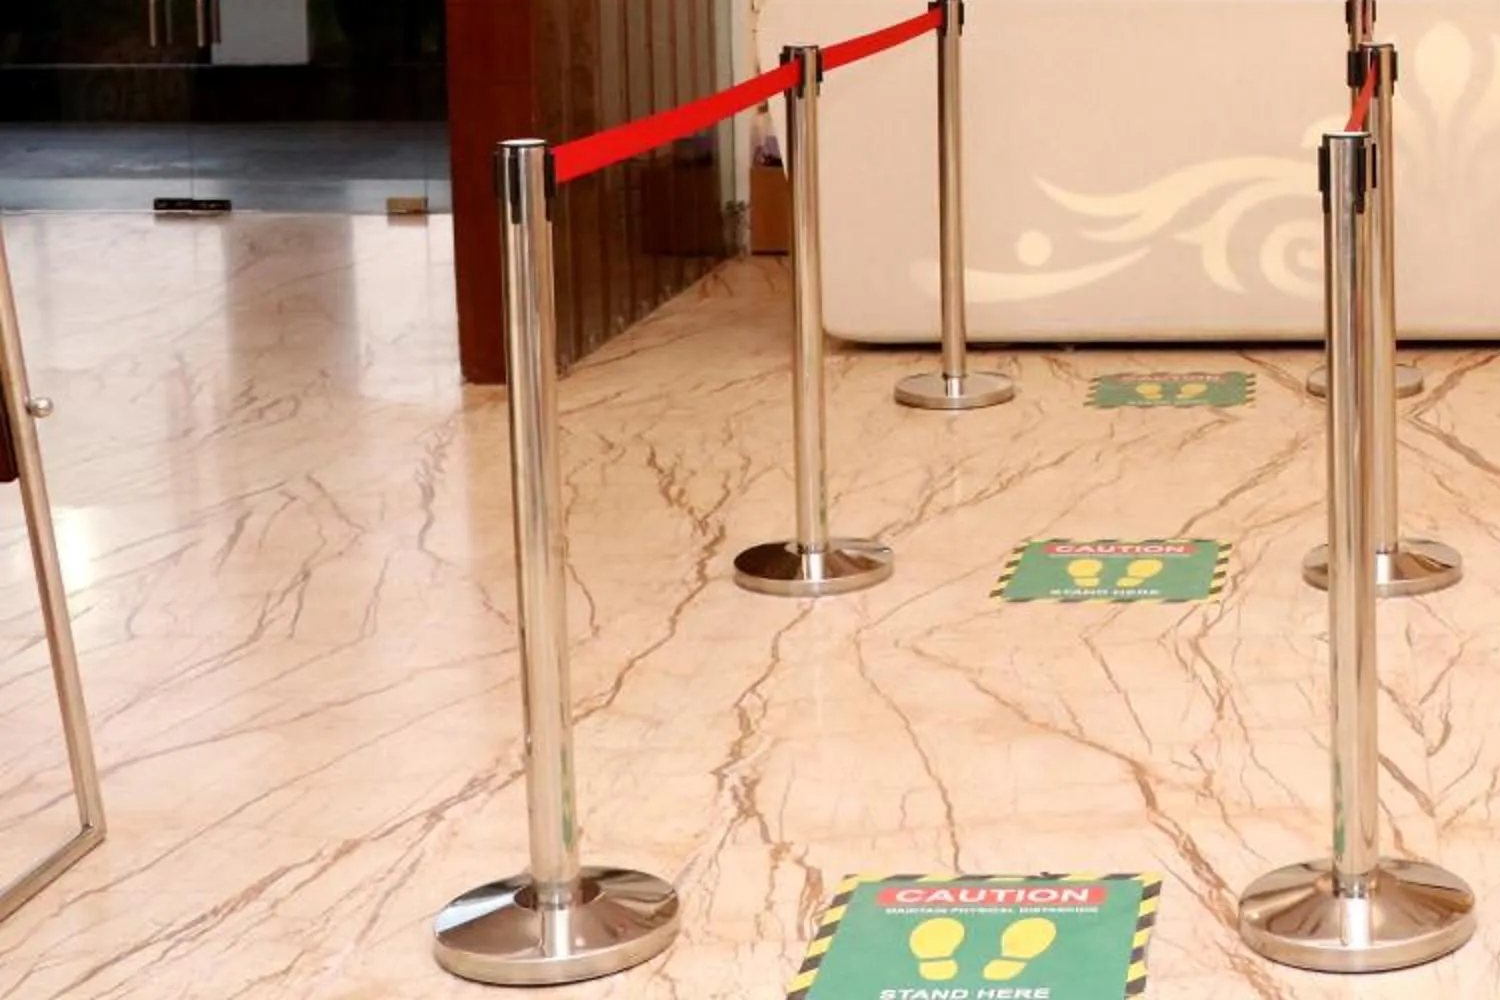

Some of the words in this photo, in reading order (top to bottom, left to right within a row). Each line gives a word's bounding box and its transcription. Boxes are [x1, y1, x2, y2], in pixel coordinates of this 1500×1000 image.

[1055, 545, 1185, 553] CAUTION
[894, 887, 1090, 903] CAUTION
[880, 988, 969, 1000] STAND
[975, 987, 1050, 1000] HERE
